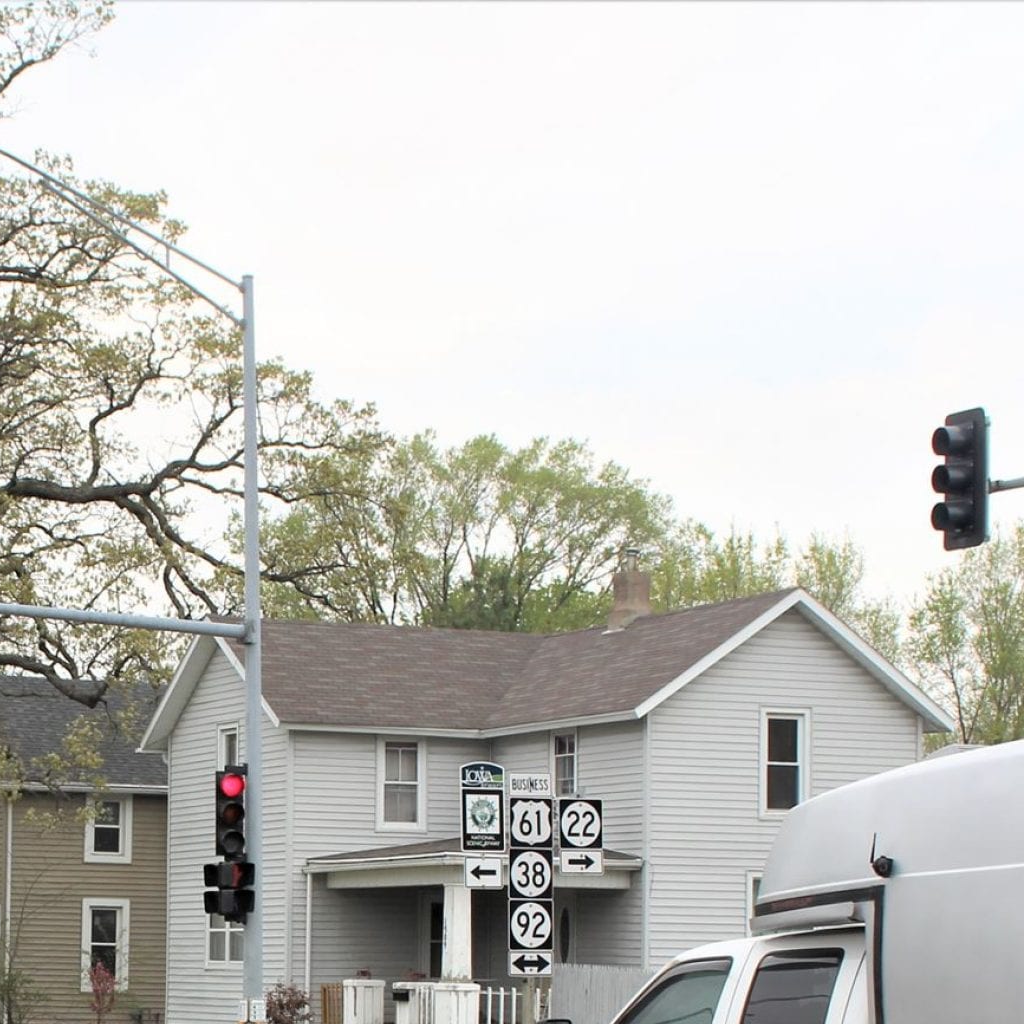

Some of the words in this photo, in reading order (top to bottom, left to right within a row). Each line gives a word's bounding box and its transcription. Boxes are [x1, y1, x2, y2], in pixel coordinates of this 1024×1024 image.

[511, 778, 549, 791] BUSINESS
[519, 810, 542, 836] 61
[567, 811, 595, 837] 22
[517, 861, 545, 888] 38
[517, 911, 545, 938] 92
